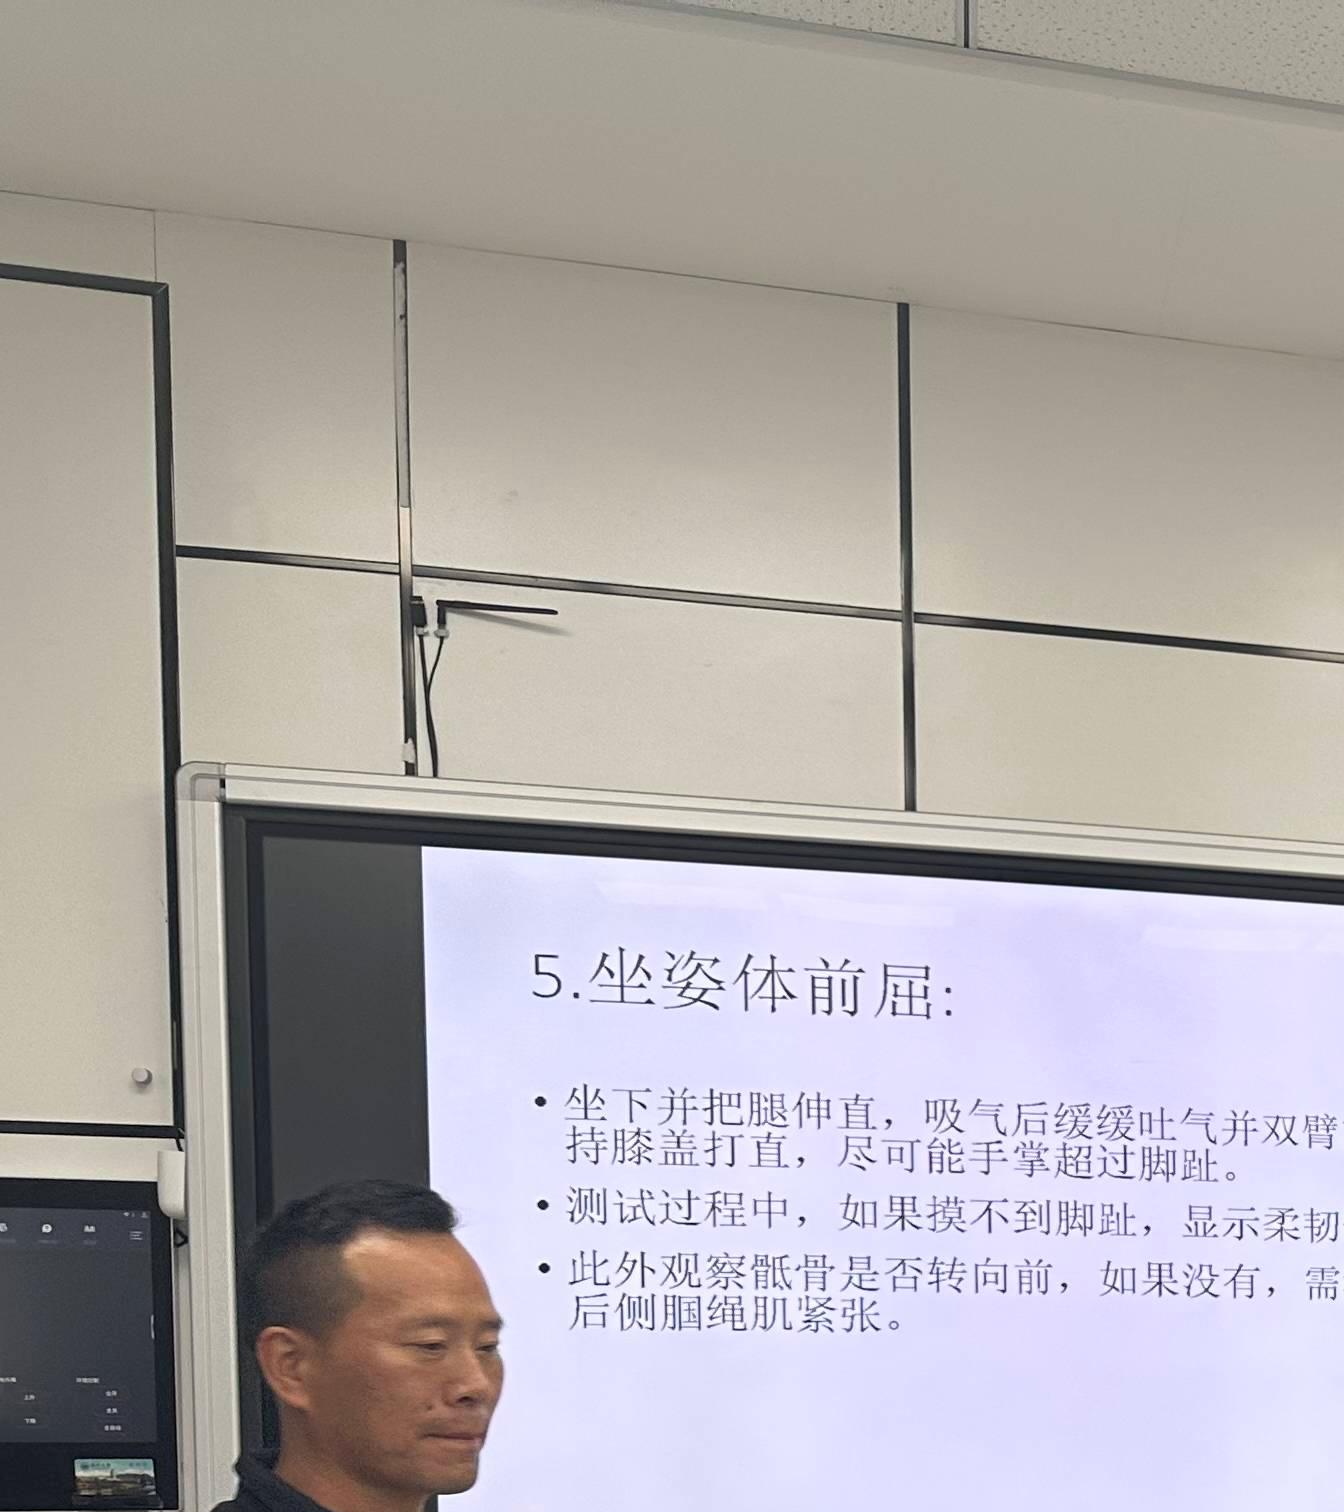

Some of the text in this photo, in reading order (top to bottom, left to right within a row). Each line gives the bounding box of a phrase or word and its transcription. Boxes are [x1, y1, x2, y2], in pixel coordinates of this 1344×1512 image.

[532, 946, 953, 1020] 5.坐姿体前屈:
[565, 1125, 1237, 1184] 持膝盖打直，尽可能手掌超过脚趾。
